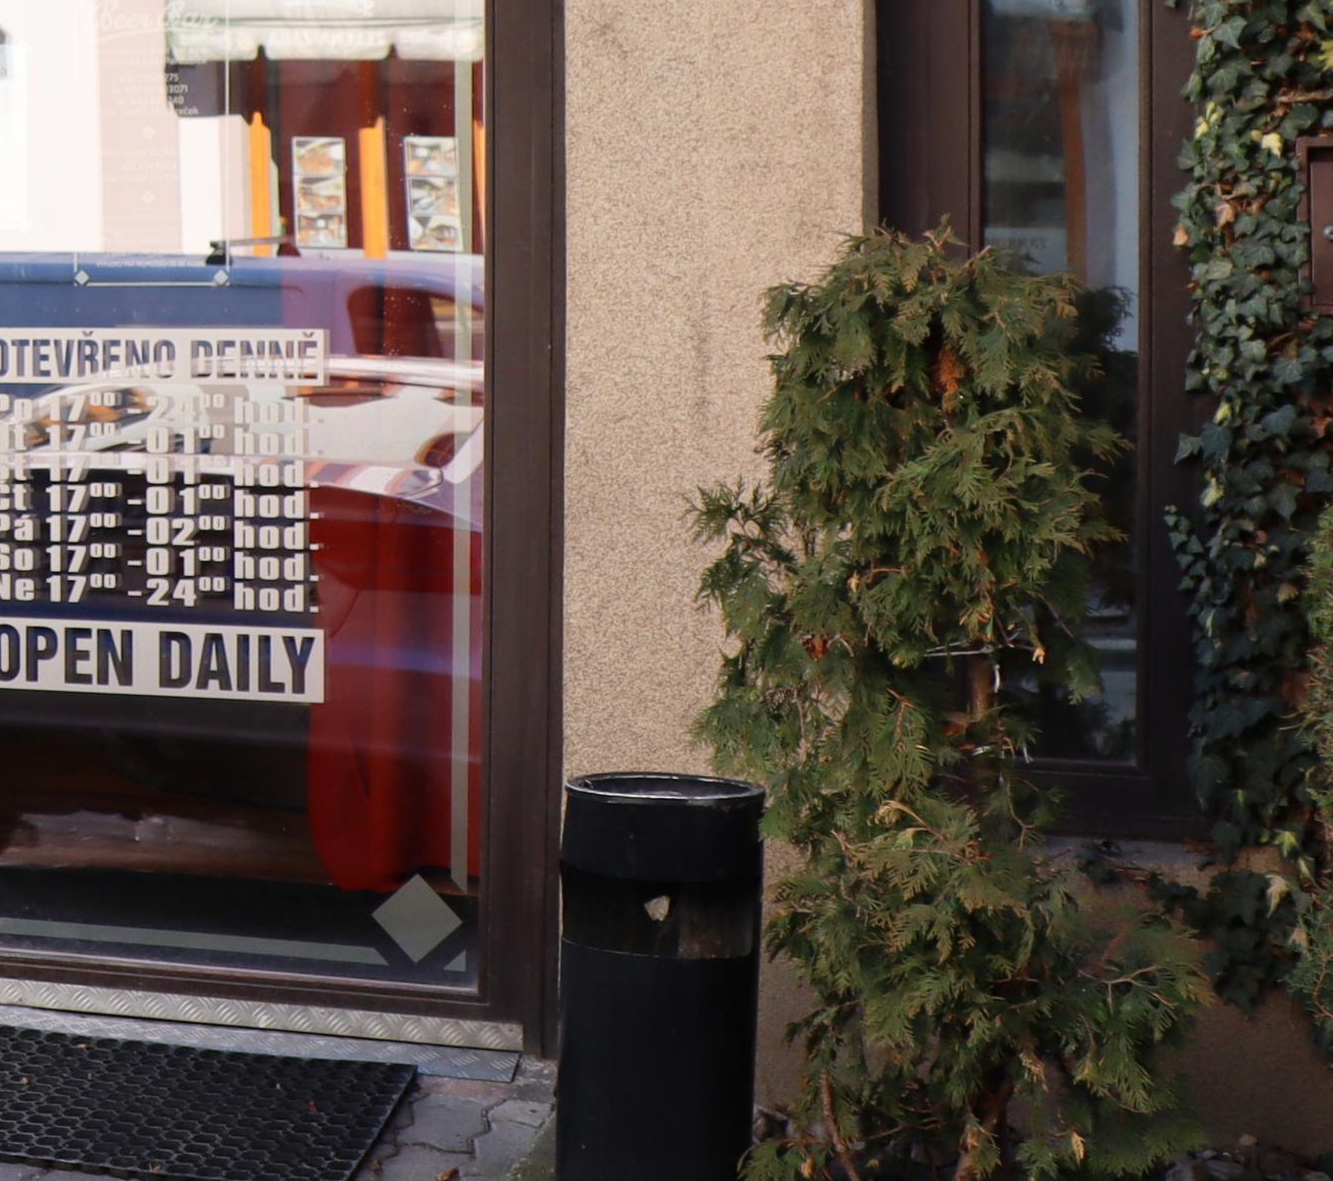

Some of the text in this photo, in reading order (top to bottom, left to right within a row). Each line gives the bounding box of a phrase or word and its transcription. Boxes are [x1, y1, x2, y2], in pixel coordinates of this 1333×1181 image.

[191, 331, 318, 379] DENNĚ
[234, 458, 319, 488] hod.
[234, 489, 319, 519] hod.
[234, 520, 319, 551] hod.
[234, 551, 319, 581] hod.
[234, 583, 319, 613] hod.
[159, 630, 315, 694] DAILY
